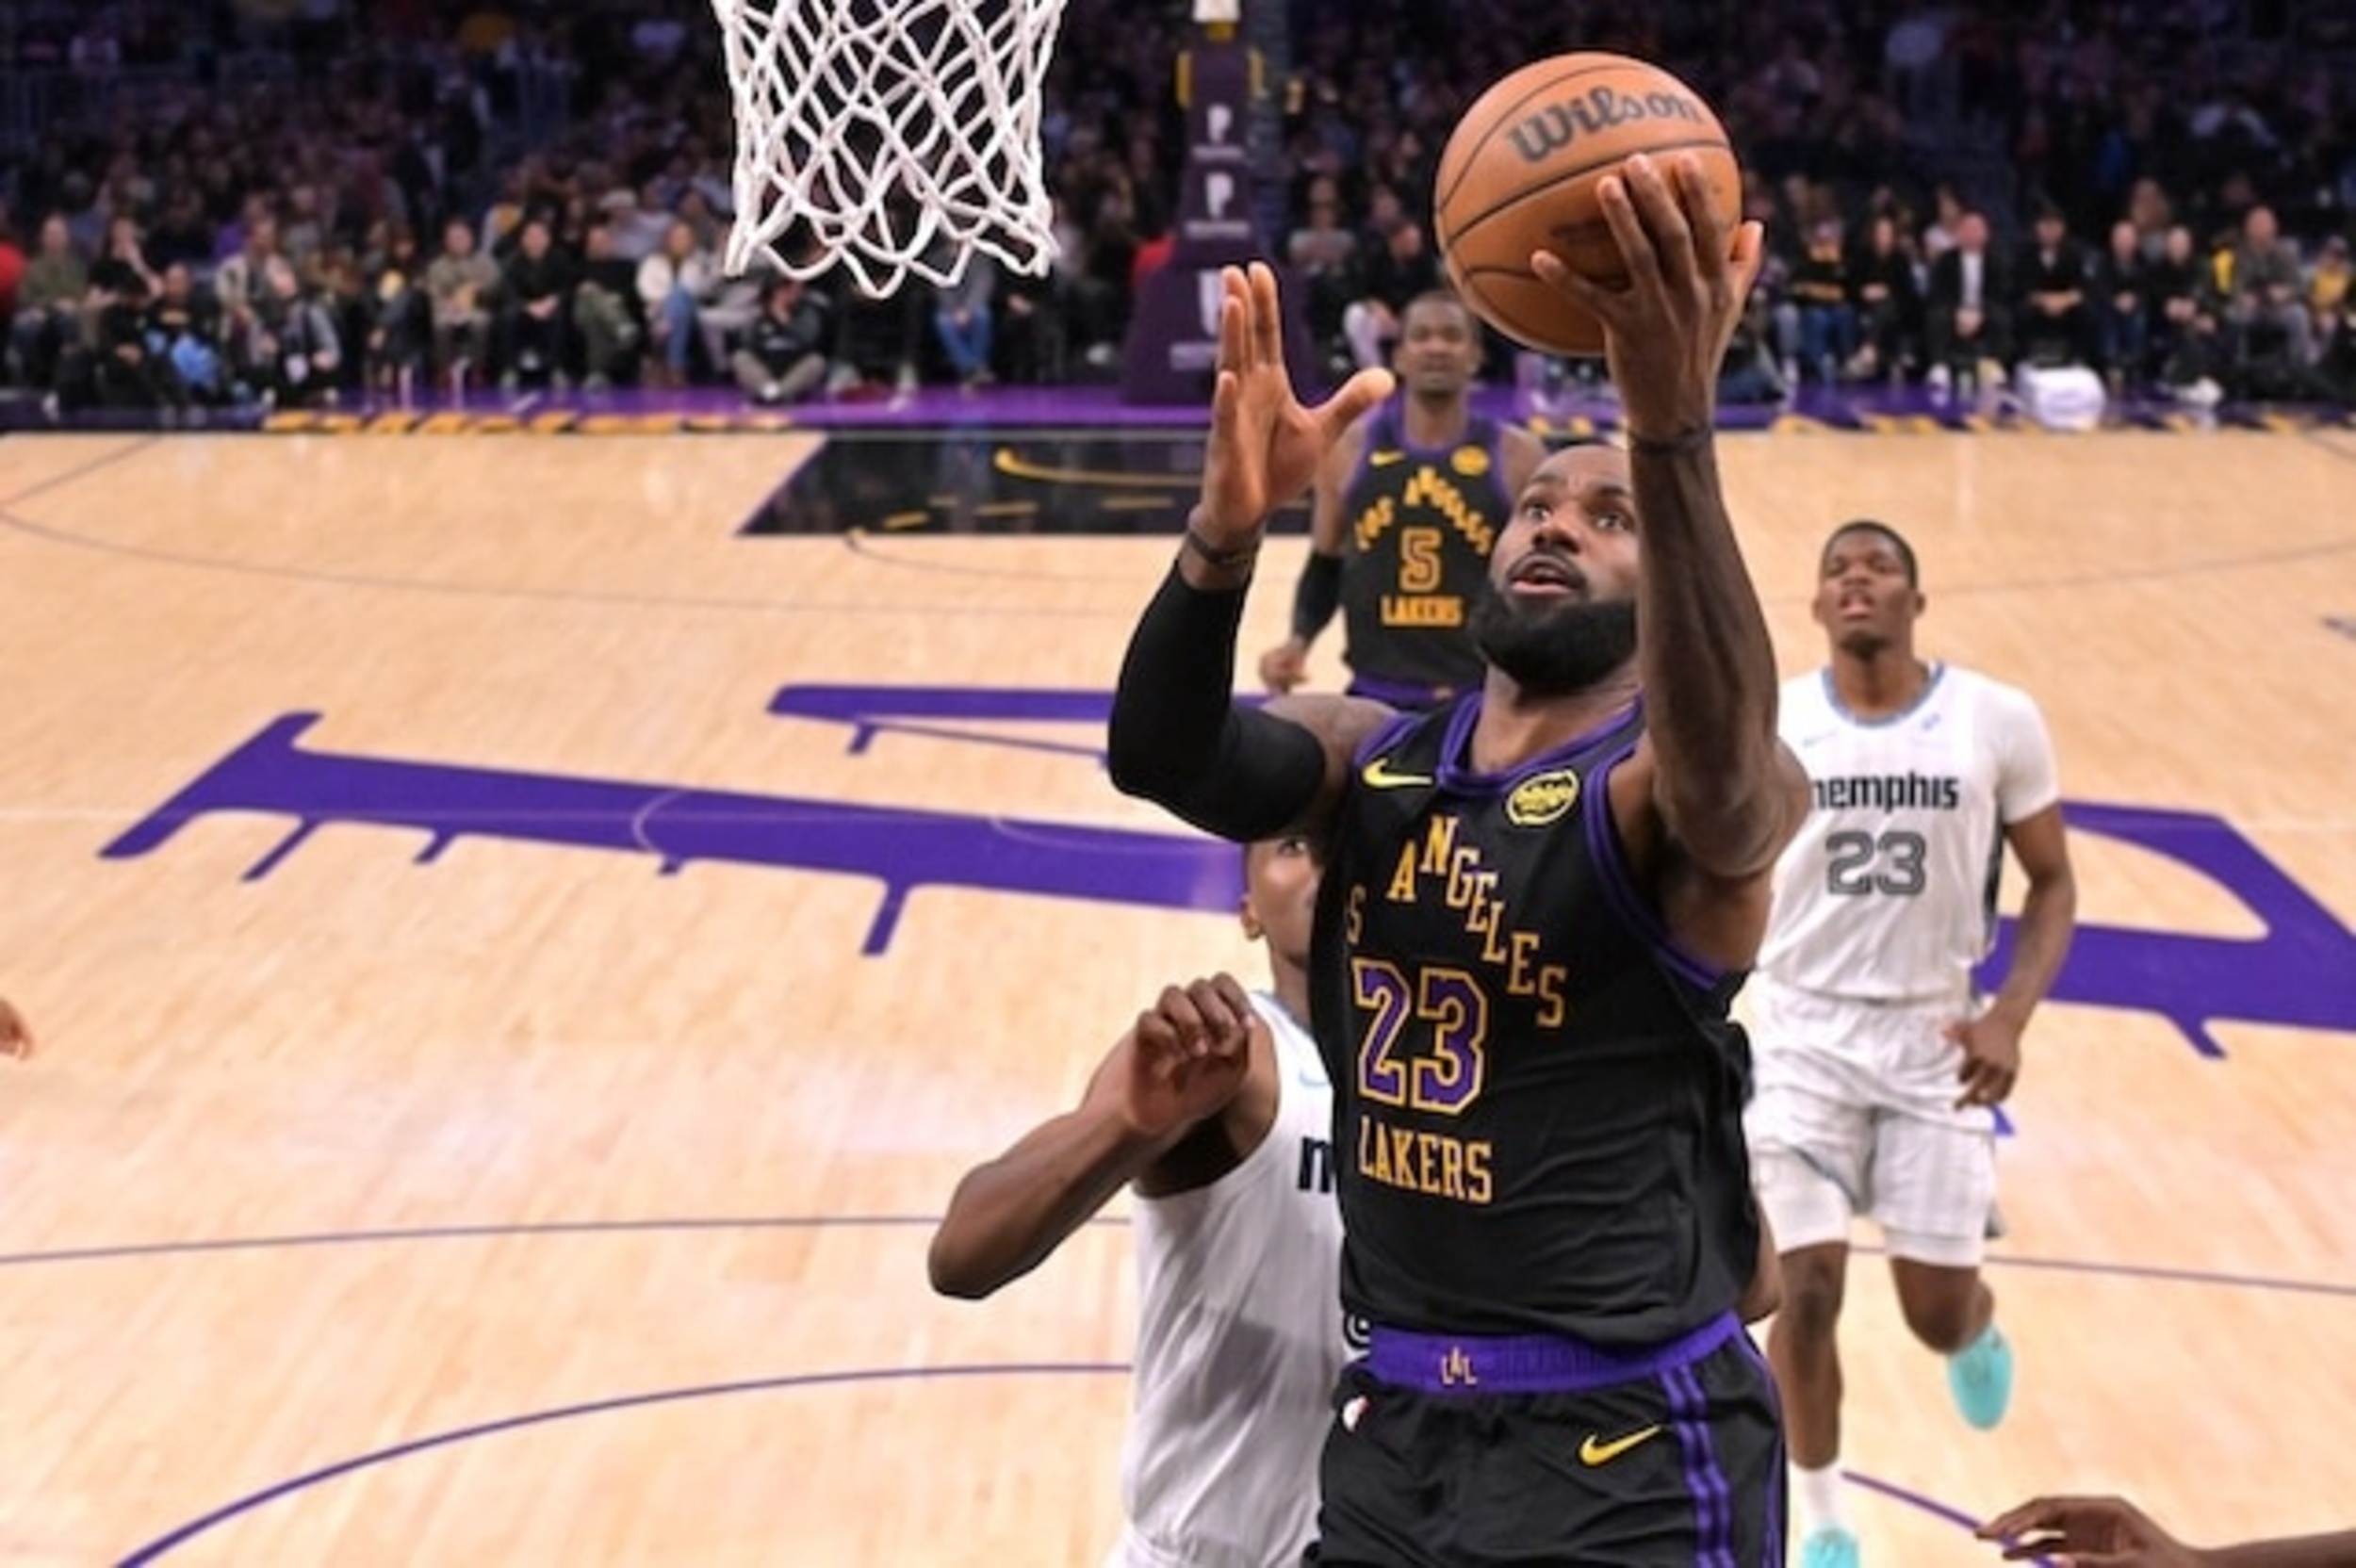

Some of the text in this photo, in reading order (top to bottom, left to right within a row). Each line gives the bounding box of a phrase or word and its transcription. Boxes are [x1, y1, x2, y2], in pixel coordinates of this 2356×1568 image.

[1509, 85, 1706, 162] Wilson
[1399, 528, 1442, 592] 5
[1824, 830, 1926, 895] 23
[1385, 814, 1567, 1027] ANGELES
[1351, 957, 1487, 1114] 23
[1359, 1116, 1492, 1204] LAKERS
